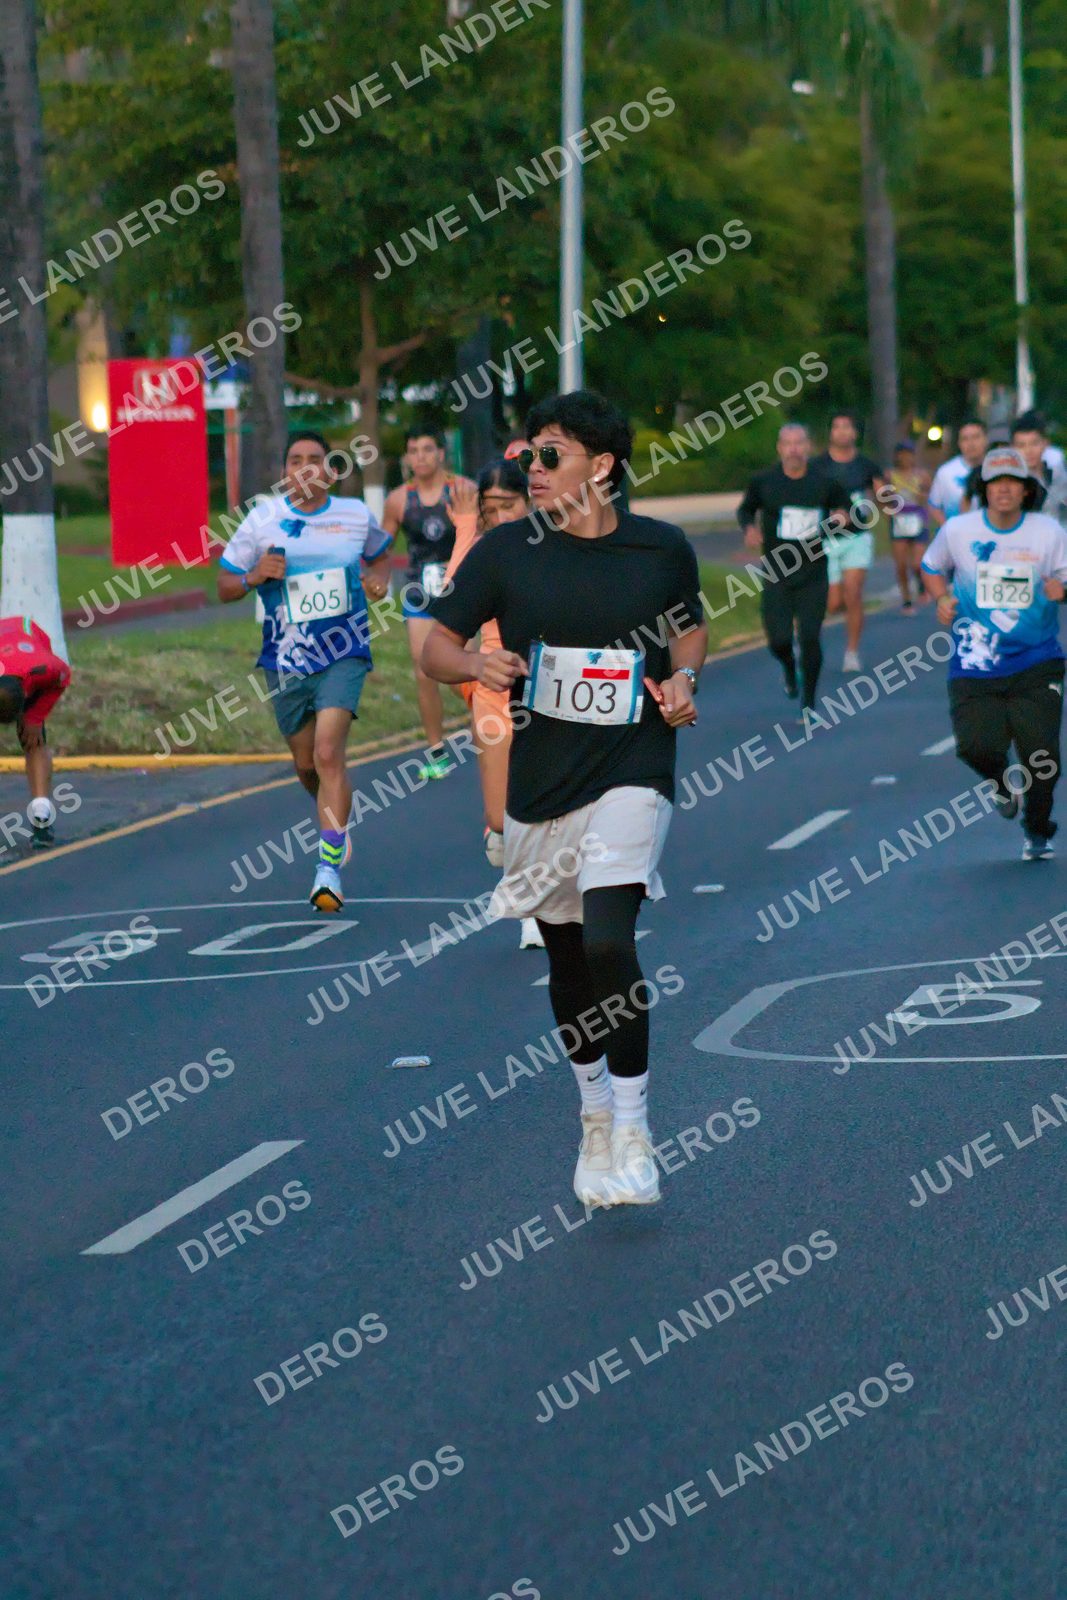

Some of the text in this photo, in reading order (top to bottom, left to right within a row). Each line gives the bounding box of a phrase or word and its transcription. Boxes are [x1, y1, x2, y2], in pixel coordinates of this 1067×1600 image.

[299, 588, 341, 614] 605
[980, 584, 1031, 603] 1826
[552, 679, 617, 714] 103
